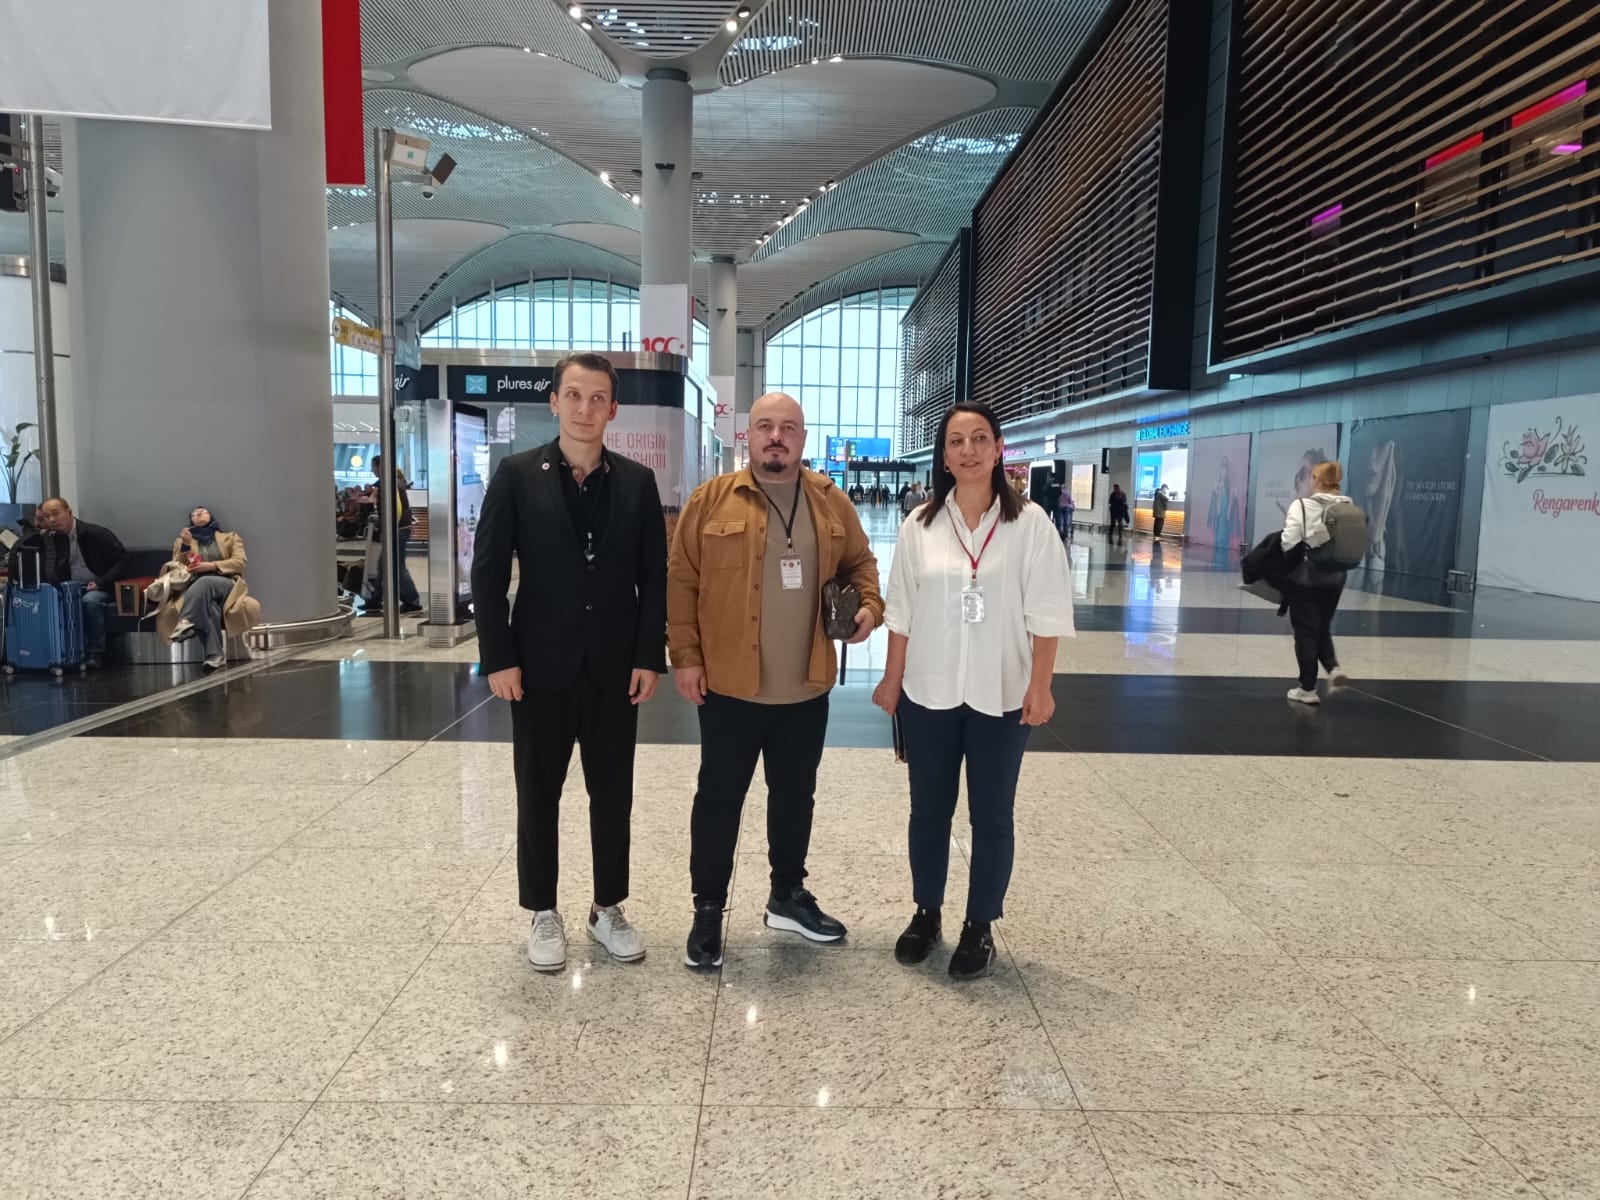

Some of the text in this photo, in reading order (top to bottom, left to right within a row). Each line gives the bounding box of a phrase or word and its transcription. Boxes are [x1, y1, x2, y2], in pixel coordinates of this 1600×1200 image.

[497, 375, 551, 392] plures air
[1140, 420, 1190, 440] GLOBAL EXCHANGE
[605, 431, 666, 450] HE ORIGIN
[1436, 481, 1456, 490] STORE
[1405, 492, 1447, 501] COMING SOON
[1533, 488, 1600, 518] Rengarenk
